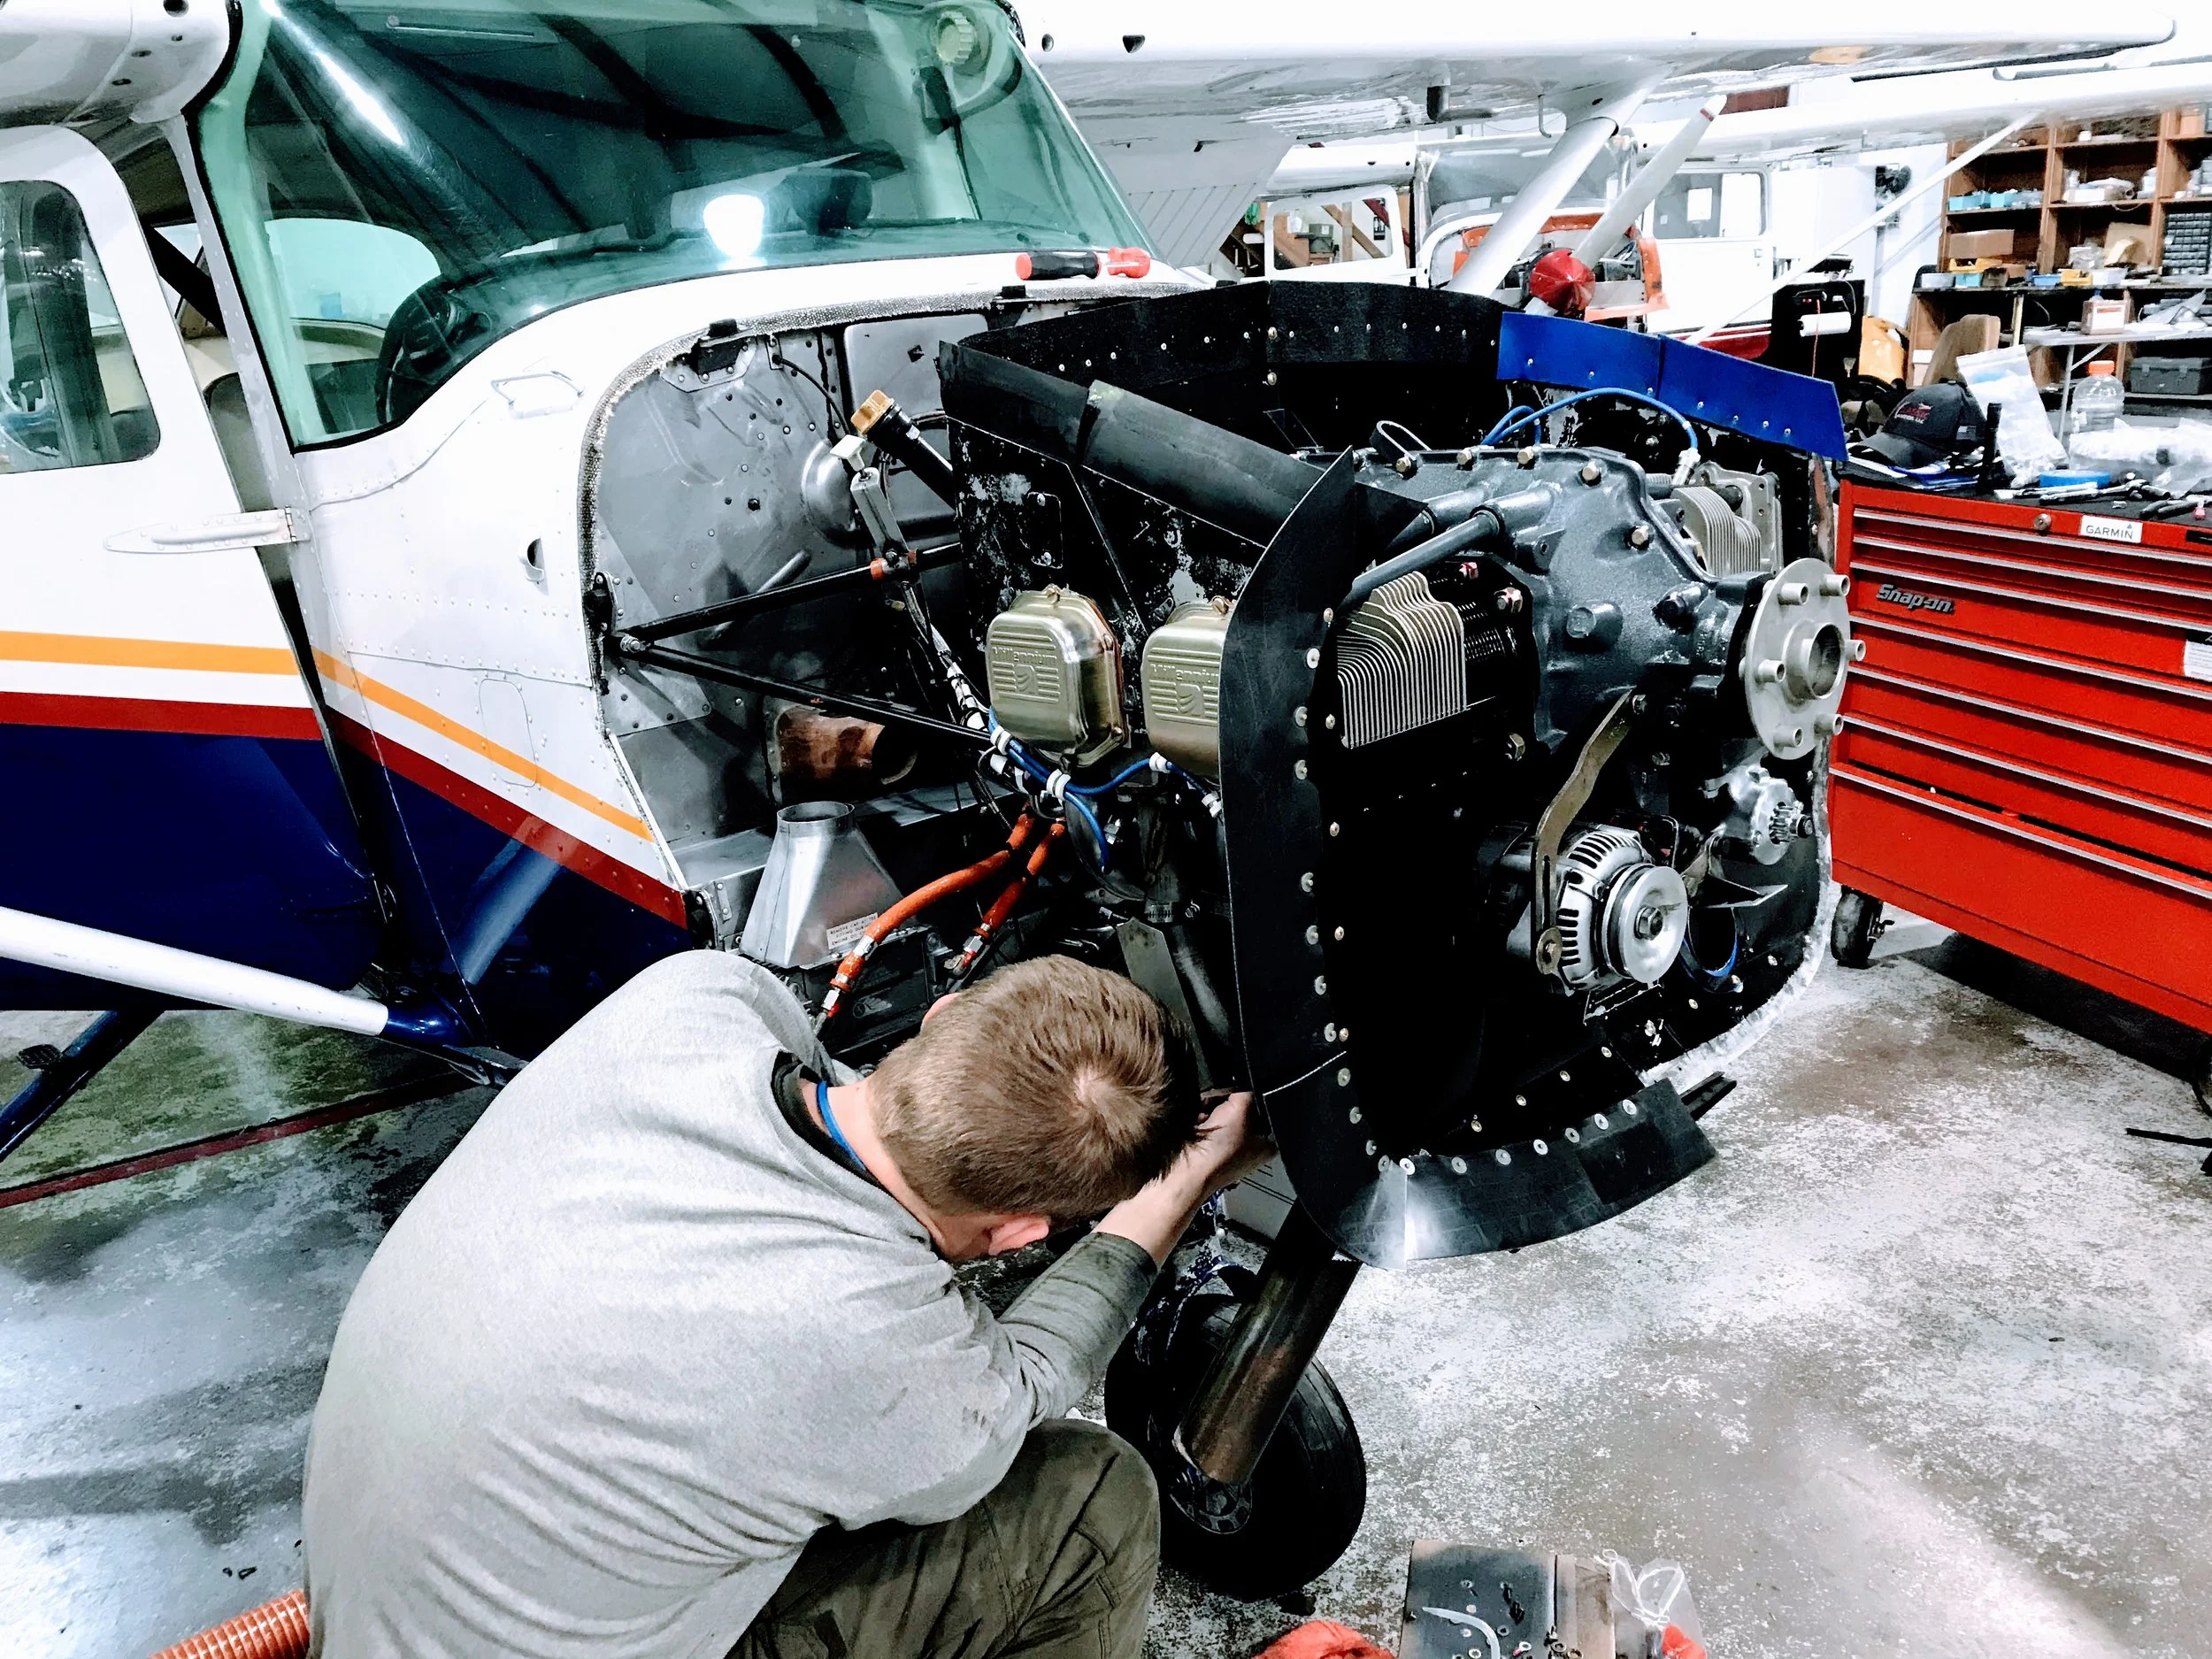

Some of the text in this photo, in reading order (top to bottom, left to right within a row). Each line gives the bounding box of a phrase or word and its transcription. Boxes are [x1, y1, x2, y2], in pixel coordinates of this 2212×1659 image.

[2085, 525, 2133, 540] GARMIN
[1876, 583, 1952, 612] Snap-on
[1150, 664, 1220, 685] Millenniu
